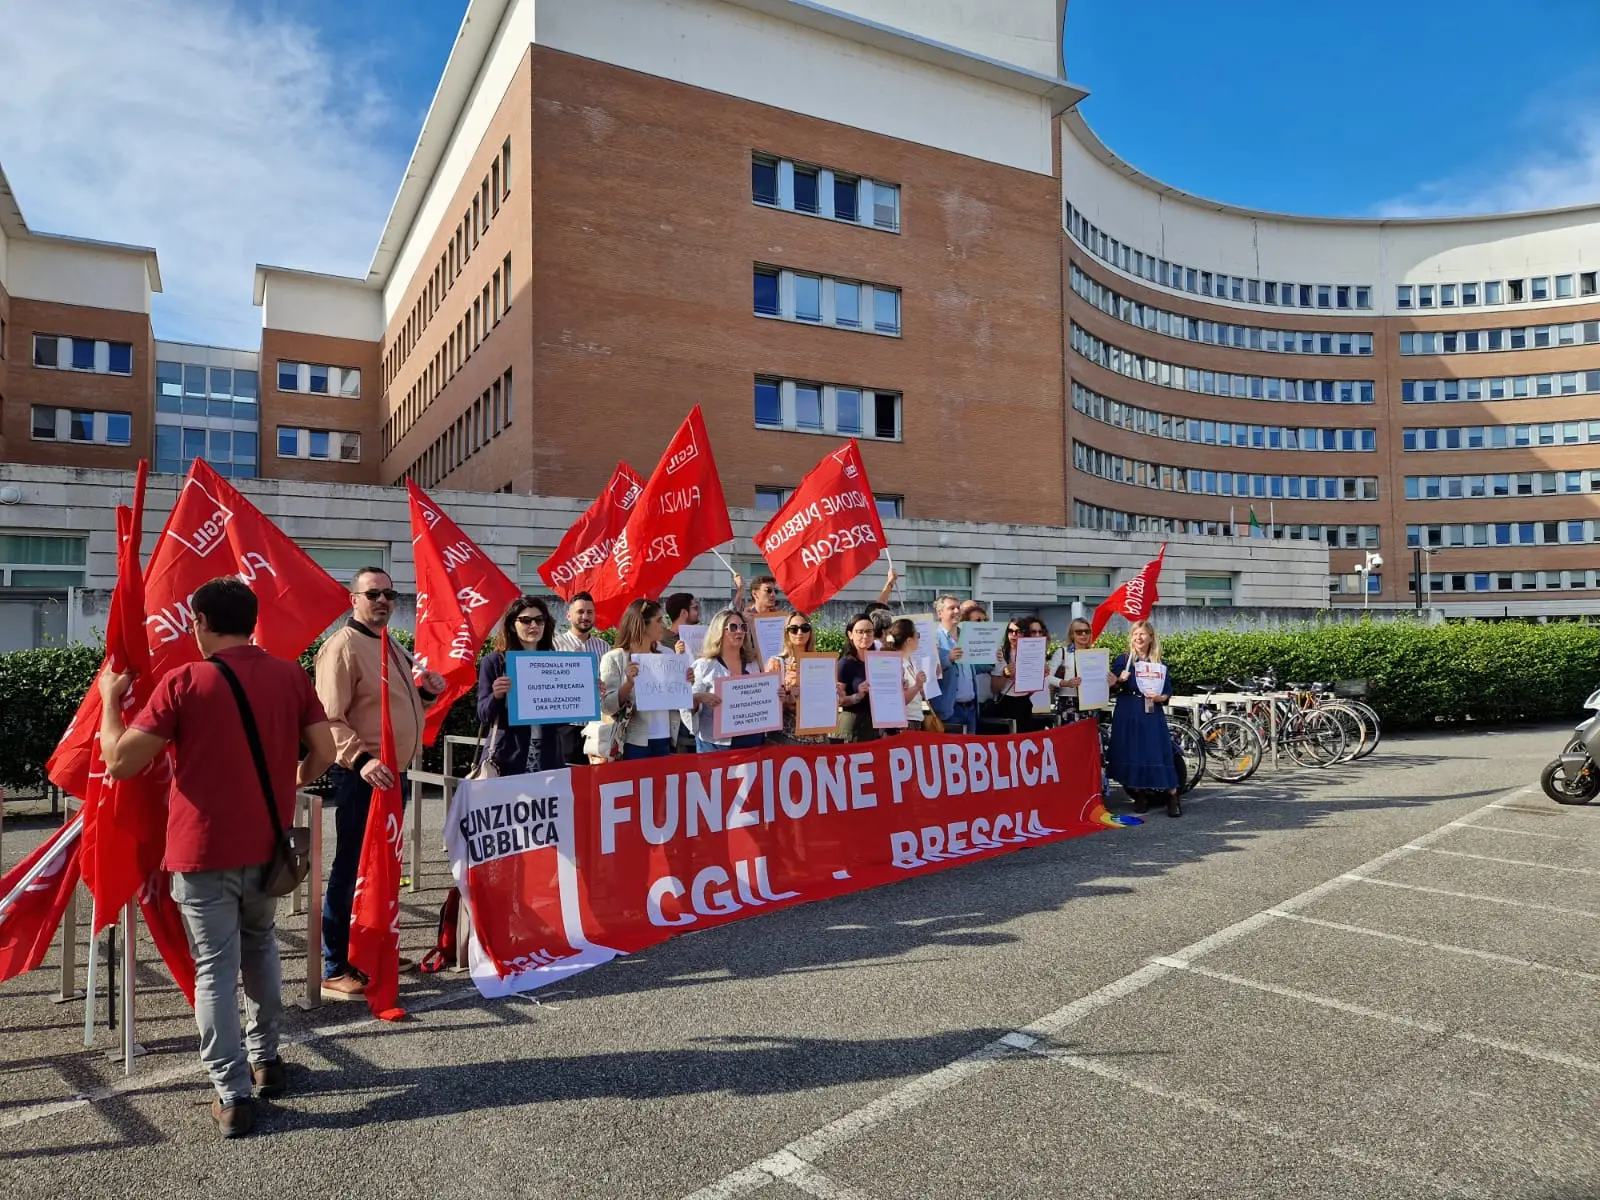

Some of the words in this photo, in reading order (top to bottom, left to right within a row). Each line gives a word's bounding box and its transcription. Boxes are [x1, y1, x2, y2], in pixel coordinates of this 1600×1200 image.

[468, 821, 560, 862] UBBLICA
[599, 752, 878, 855] FUNZIONE
[889, 737, 1060, 803] PUBBLICA
[646, 855, 801, 927] CGIL
[890, 809, 1066, 869] BRESCIA
